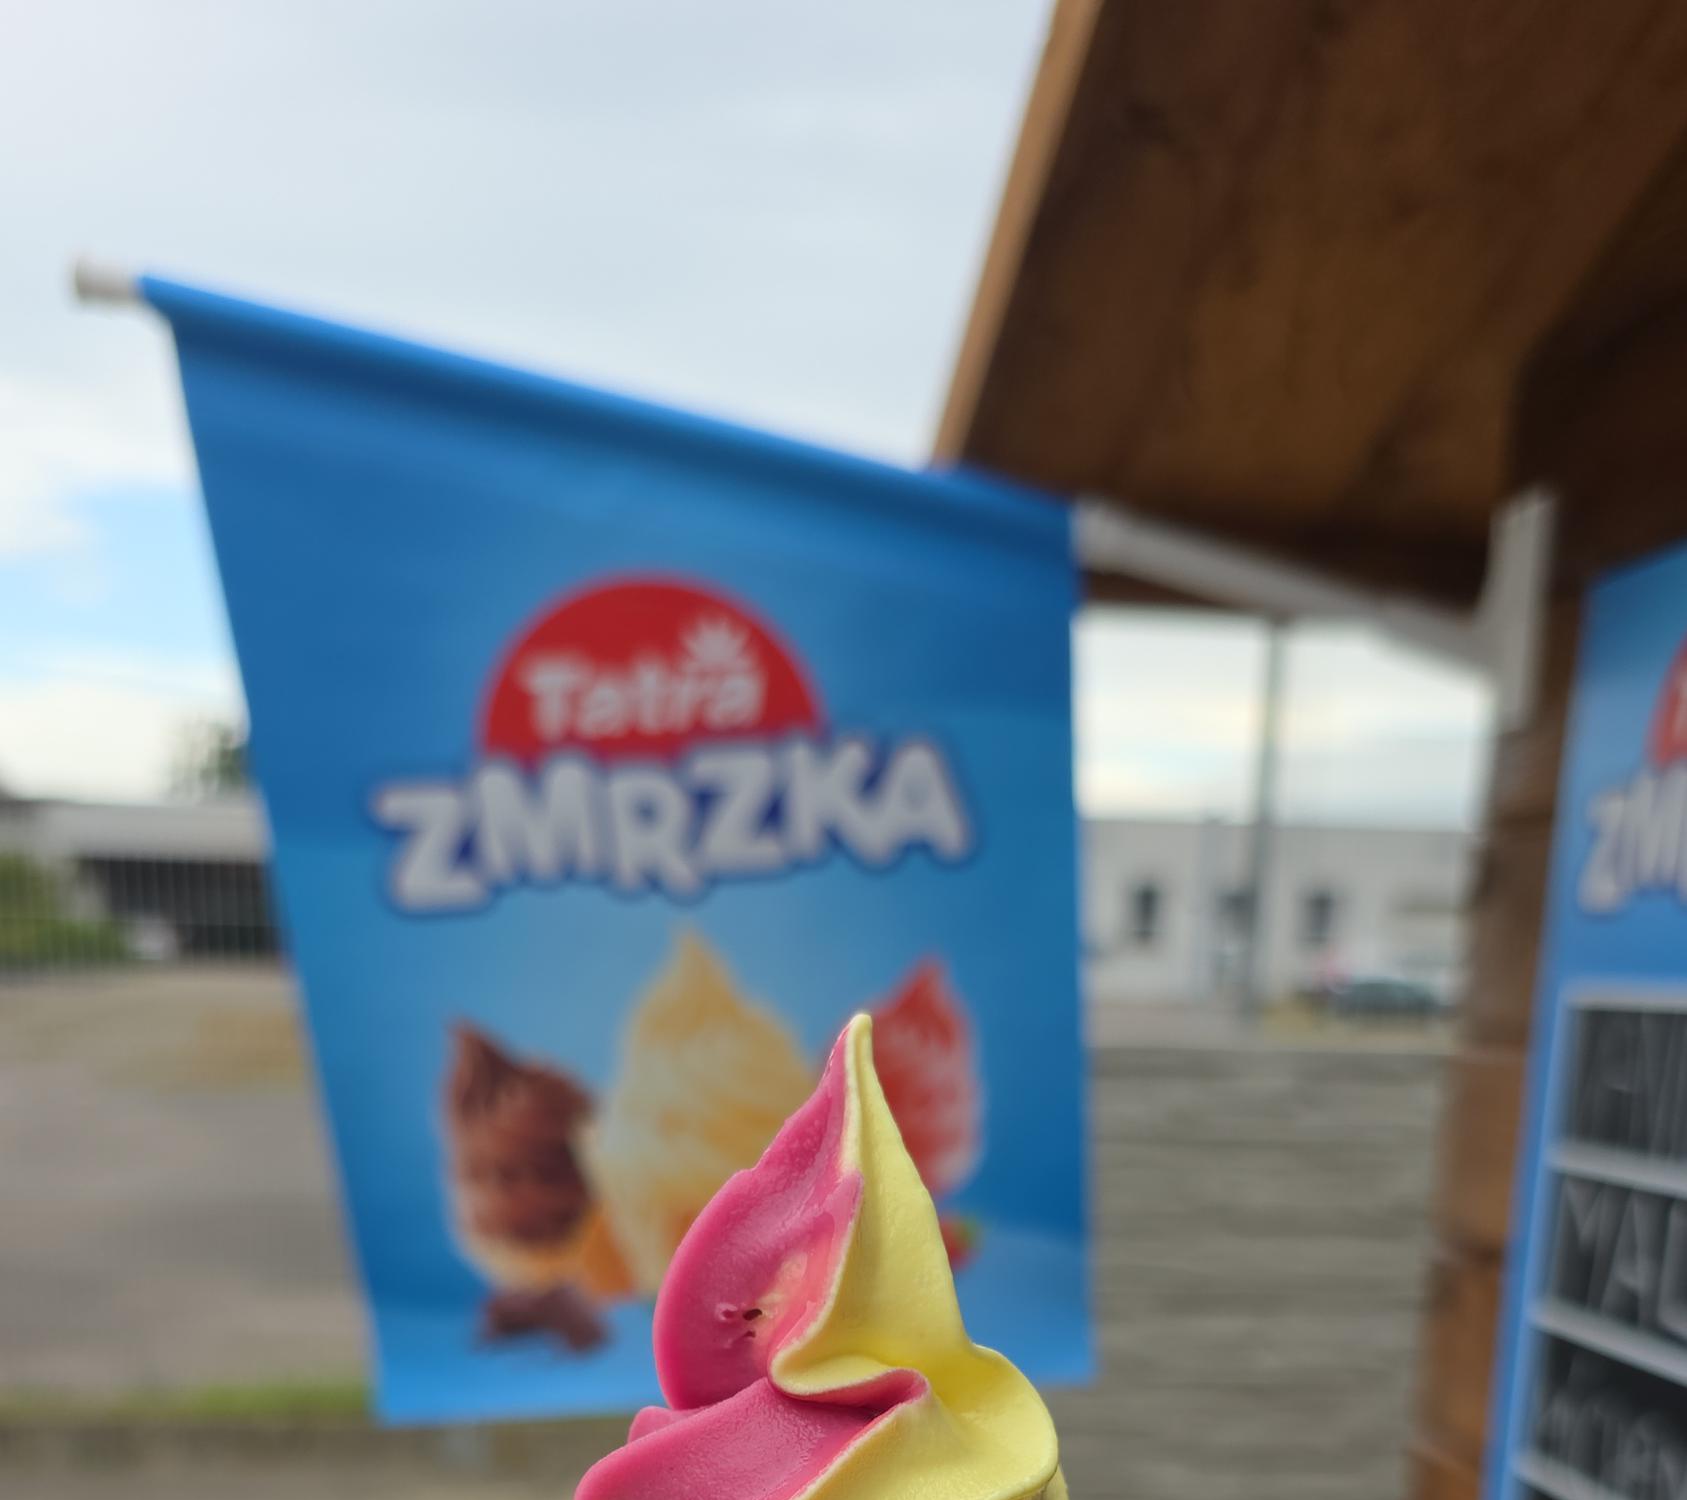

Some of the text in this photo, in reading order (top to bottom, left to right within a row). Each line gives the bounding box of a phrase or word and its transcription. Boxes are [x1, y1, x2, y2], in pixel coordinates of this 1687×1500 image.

[521, 654, 766, 738] Tatra
[378, 738, 972, 908] ZMRZKA
[1580, 764, 1687, 914] ZM
